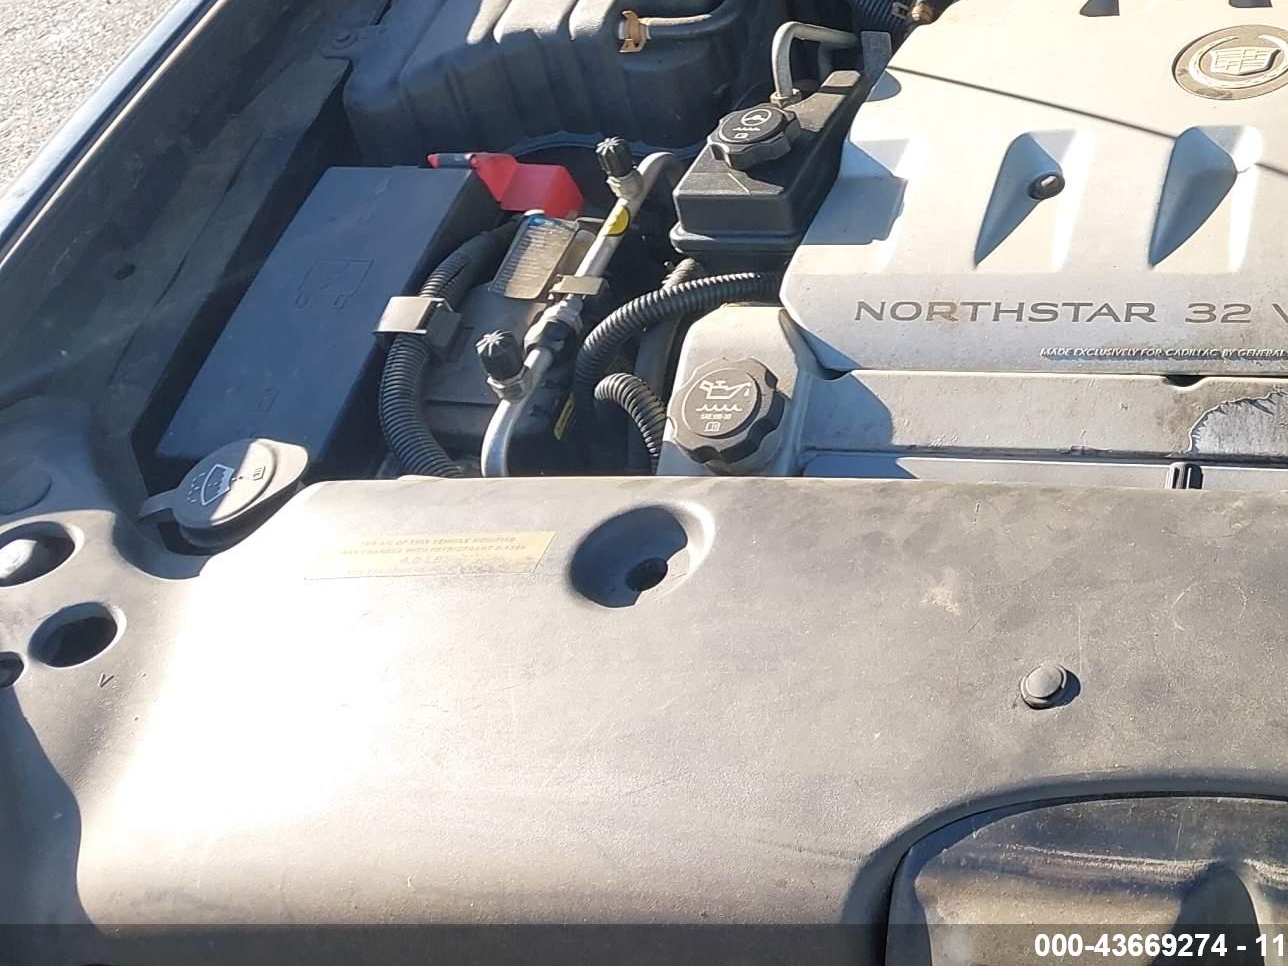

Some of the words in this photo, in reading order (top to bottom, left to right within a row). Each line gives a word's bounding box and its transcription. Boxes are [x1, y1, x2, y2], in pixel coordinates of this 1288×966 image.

[854, 300, 1158, 324] NORTHSTAR
[1184, 301, 1253, 324] 32
[1040, 347, 1073, 357] MADE
[1073, 347, 1139, 357] EXCLUSIVELY
[1140, 347, 1163, 357] FOR
[1165, 348, 1217, 357] CADILLAC
[1221, 348, 1235, 358] BY
[1237, 348, 1285, 358] GENERAL
